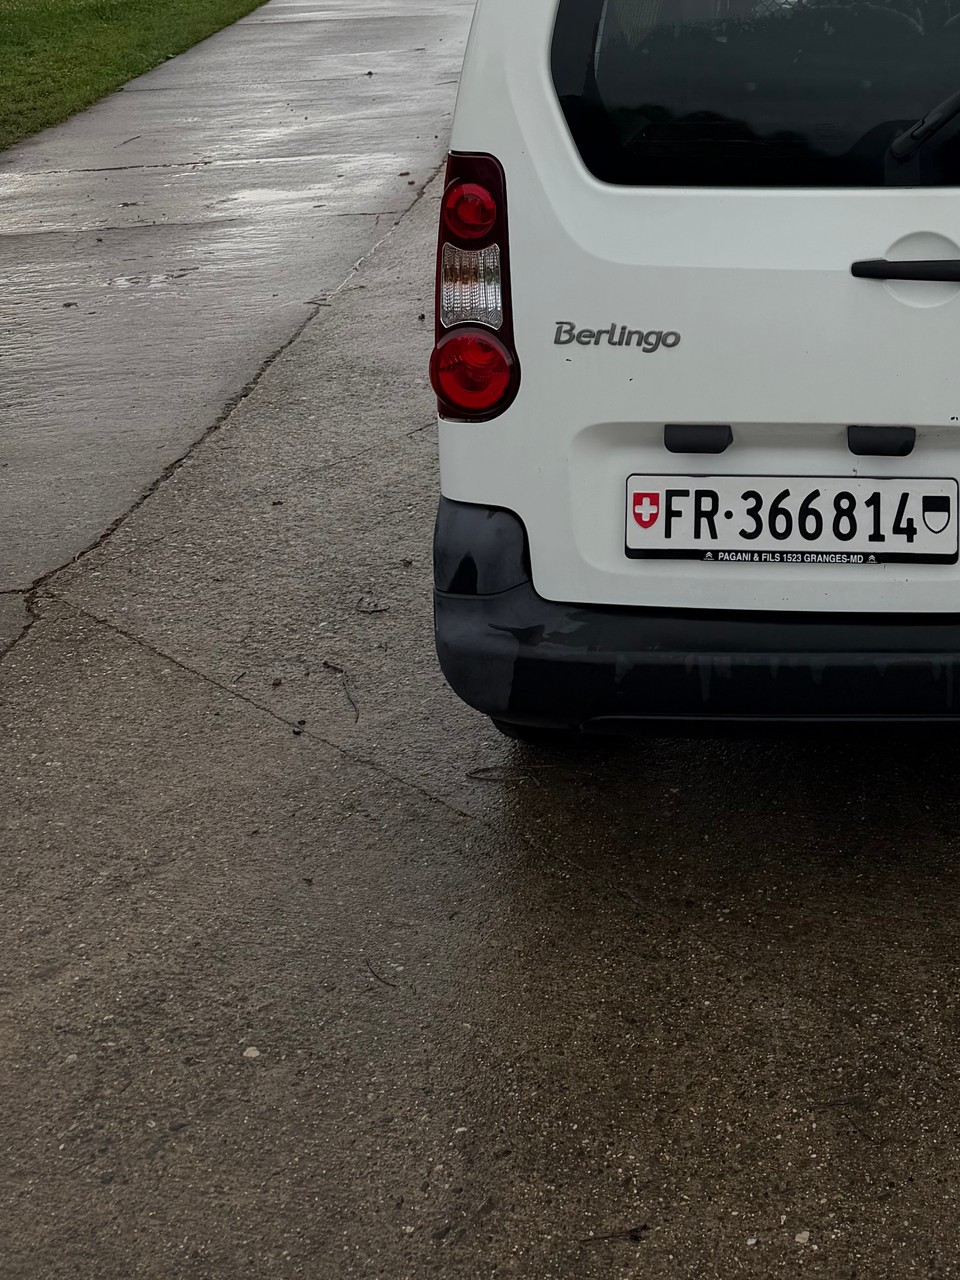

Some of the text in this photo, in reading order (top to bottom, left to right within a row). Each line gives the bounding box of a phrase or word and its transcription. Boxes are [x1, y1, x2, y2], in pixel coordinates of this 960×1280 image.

[553, 321, 681, 353] Berlingo
[718, 552, 864, 563] PAGANI & FILS 1523 GRANGES-MD
